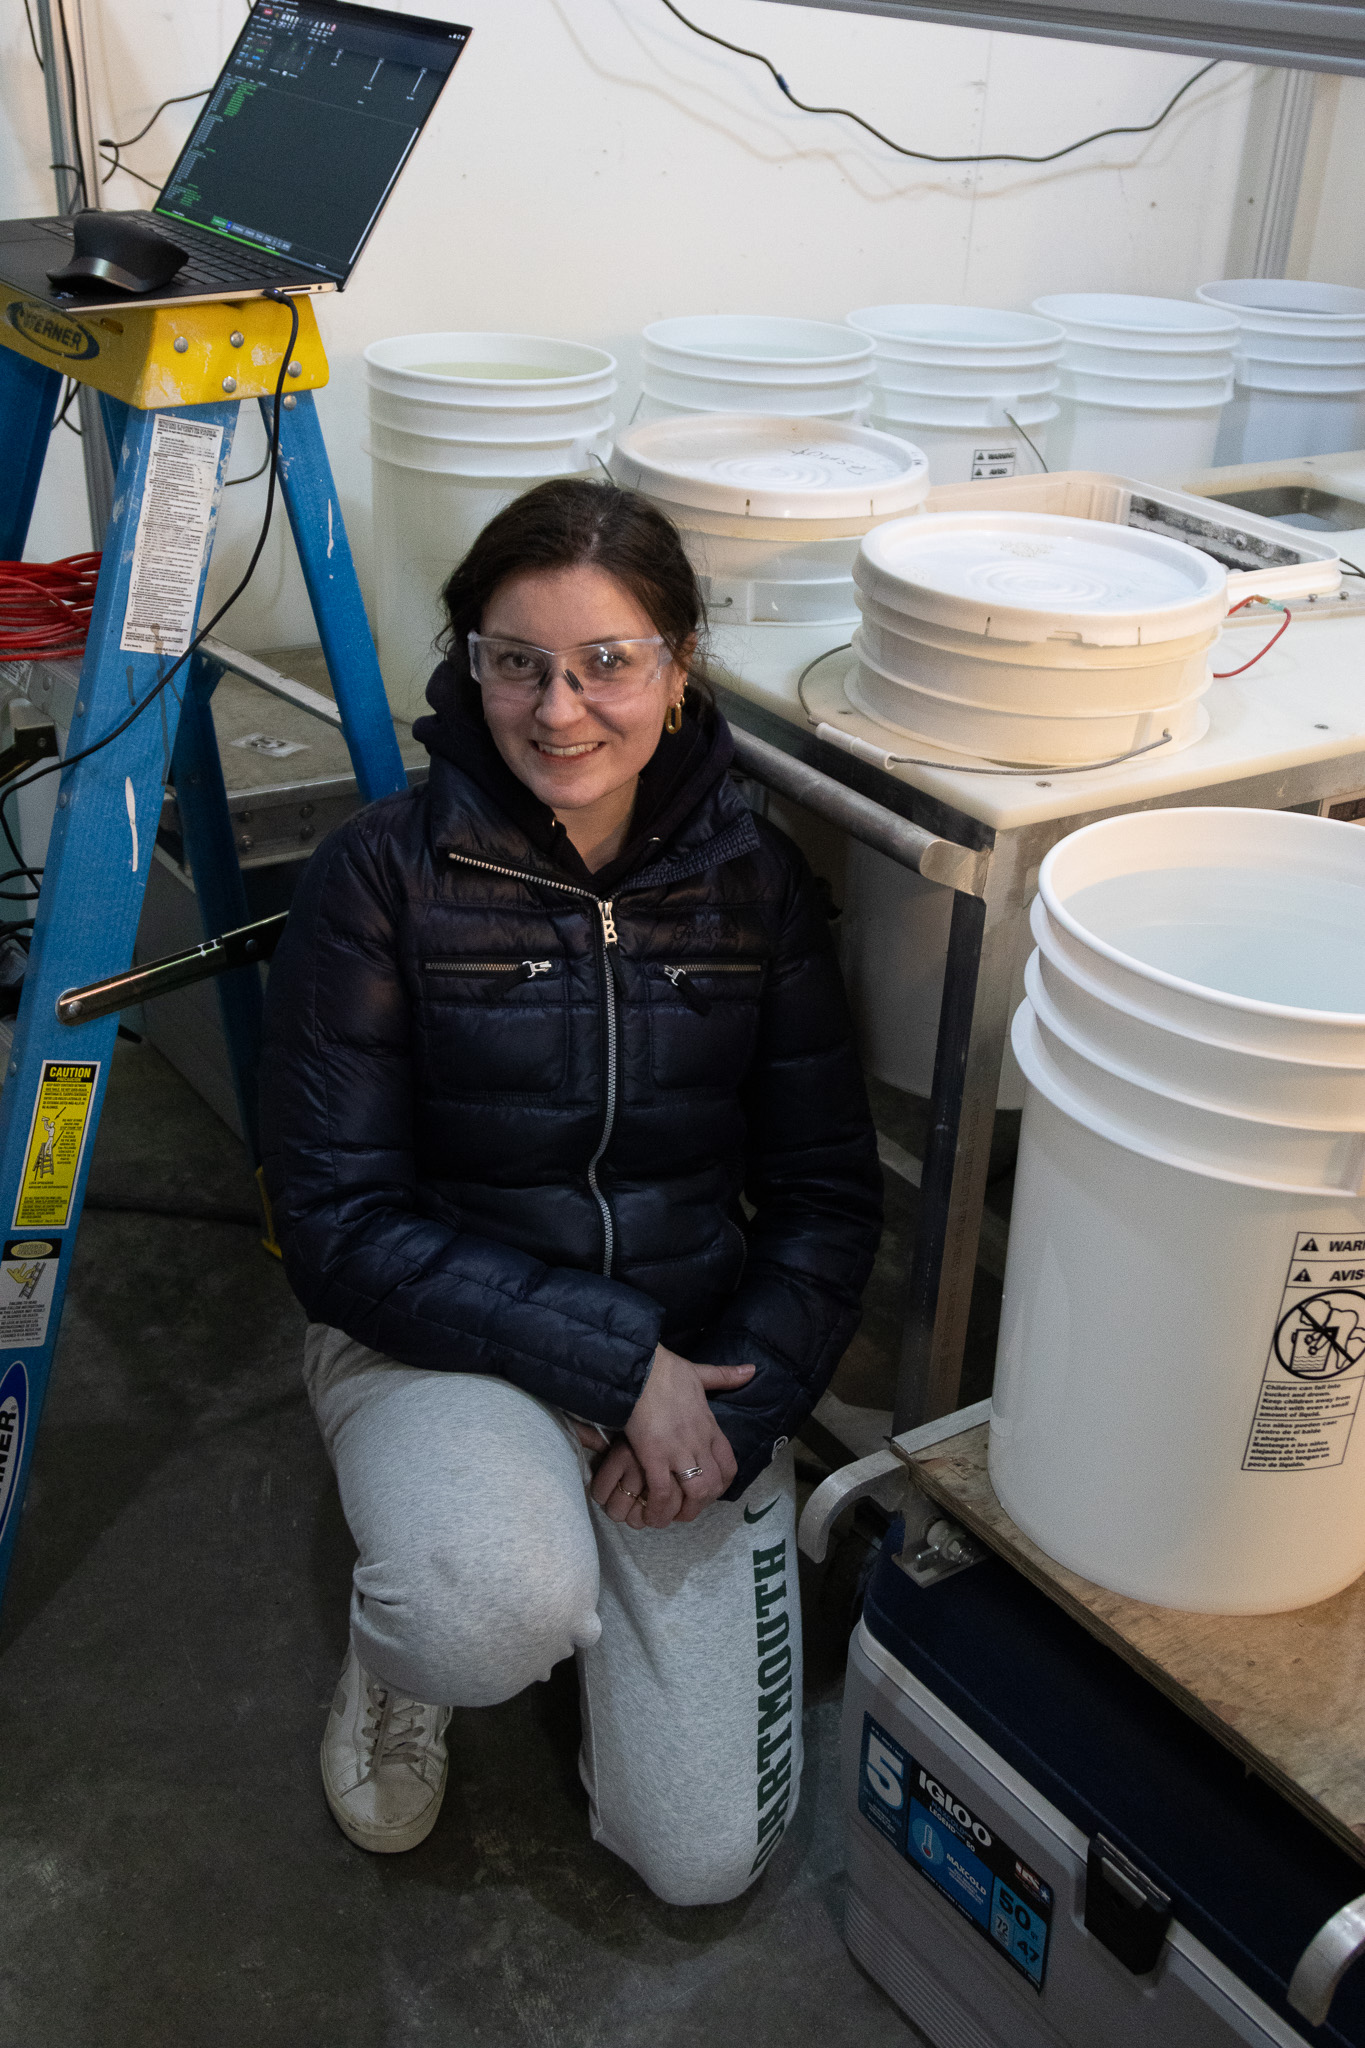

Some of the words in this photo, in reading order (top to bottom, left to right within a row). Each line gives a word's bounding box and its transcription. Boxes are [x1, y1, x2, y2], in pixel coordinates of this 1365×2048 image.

[49, 1066, 91, 1078] CAUTION
[1328, 1240, 1365, 1251] WAR
[1328, 1268, 1365, 1281] AVIS
[748, 1538, 792, 1878] DARTMOUTH
[866, 1732, 905, 1811] 5
[918, 1769, 992, 1848] IGLOO
[946, 1852, 987, 1896] MAXCOLD
[999, 1886, 1031, 1931] 50
[996, 1915, 1009, 1937] 72
[1017, 1939, 1040, 1963] 47
